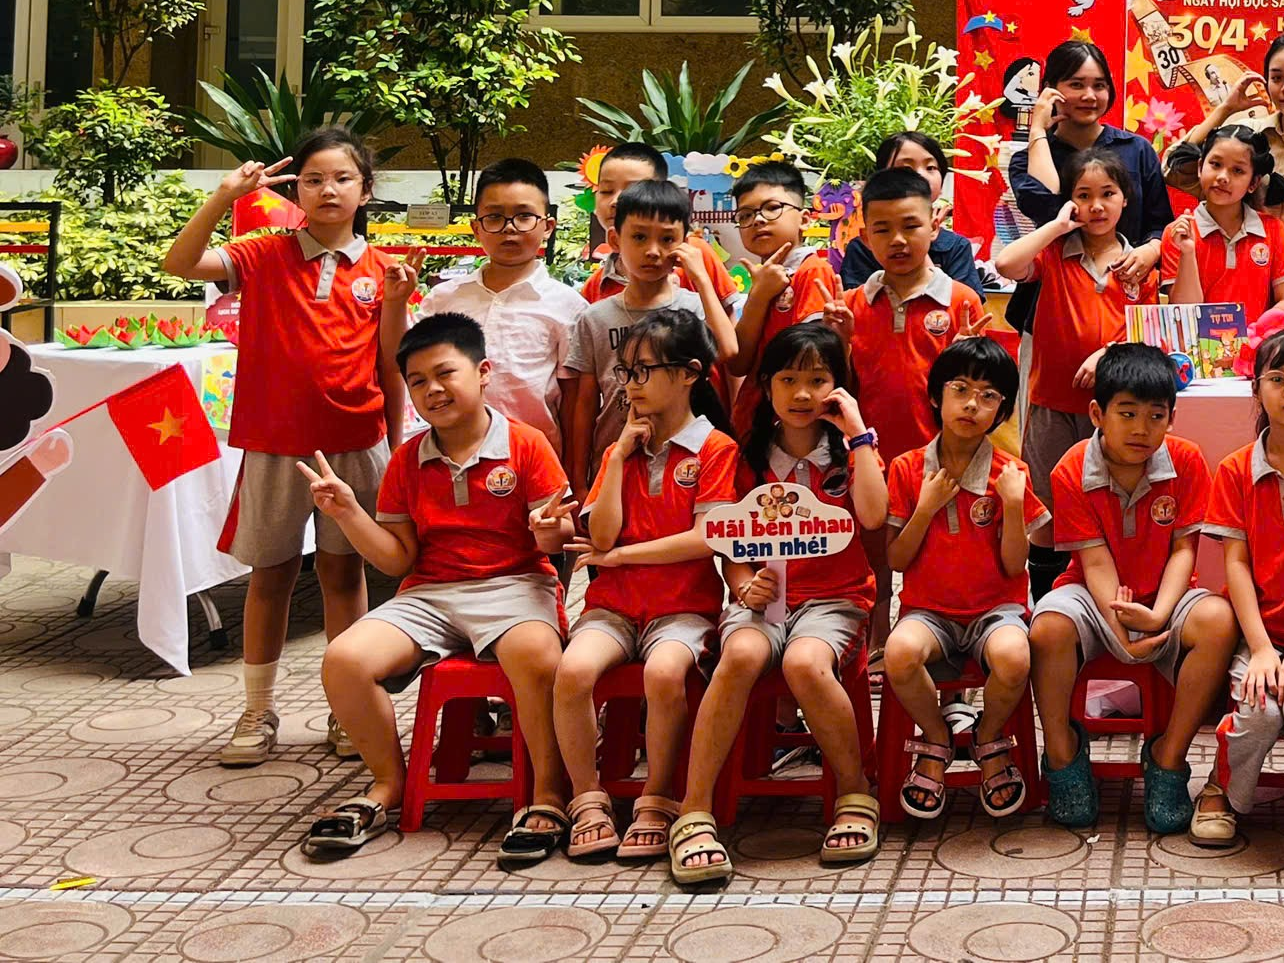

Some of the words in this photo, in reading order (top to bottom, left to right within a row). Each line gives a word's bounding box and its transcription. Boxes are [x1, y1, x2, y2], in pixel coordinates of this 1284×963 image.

[1168, 15, 1248, 54] 30/4
[1158, 47, 1180, 69] 30
[706, 519, 745, 538] Mãi
[799, 516, 853, 535] nhau
[732, 540, 773, 561] bạn
[779, 536, 828, 556] nhé!
